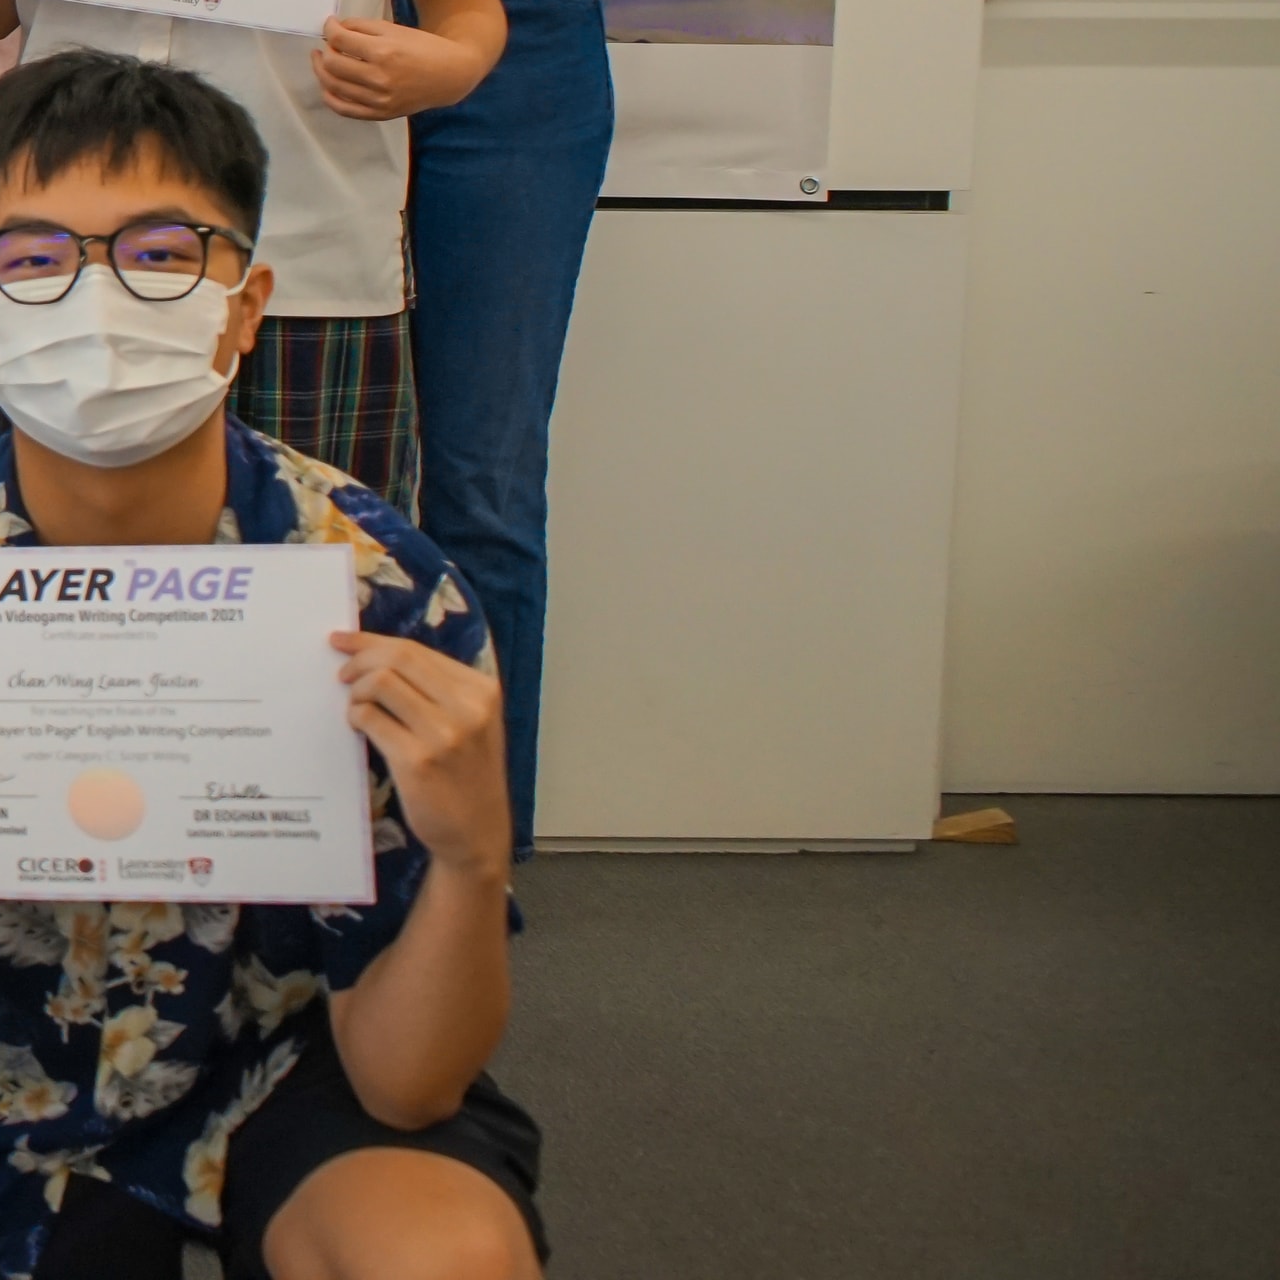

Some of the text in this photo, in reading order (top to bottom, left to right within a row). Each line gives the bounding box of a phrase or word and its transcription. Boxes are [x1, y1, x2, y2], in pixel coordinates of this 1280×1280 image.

[126, 567, 253, 601] PAGE
[4, 610, 76, 626] Videogame
[78, 610, 126, 626] Writing
[128, 609, 208, 625] Competition
[211, 608, 243, 622] 2021
